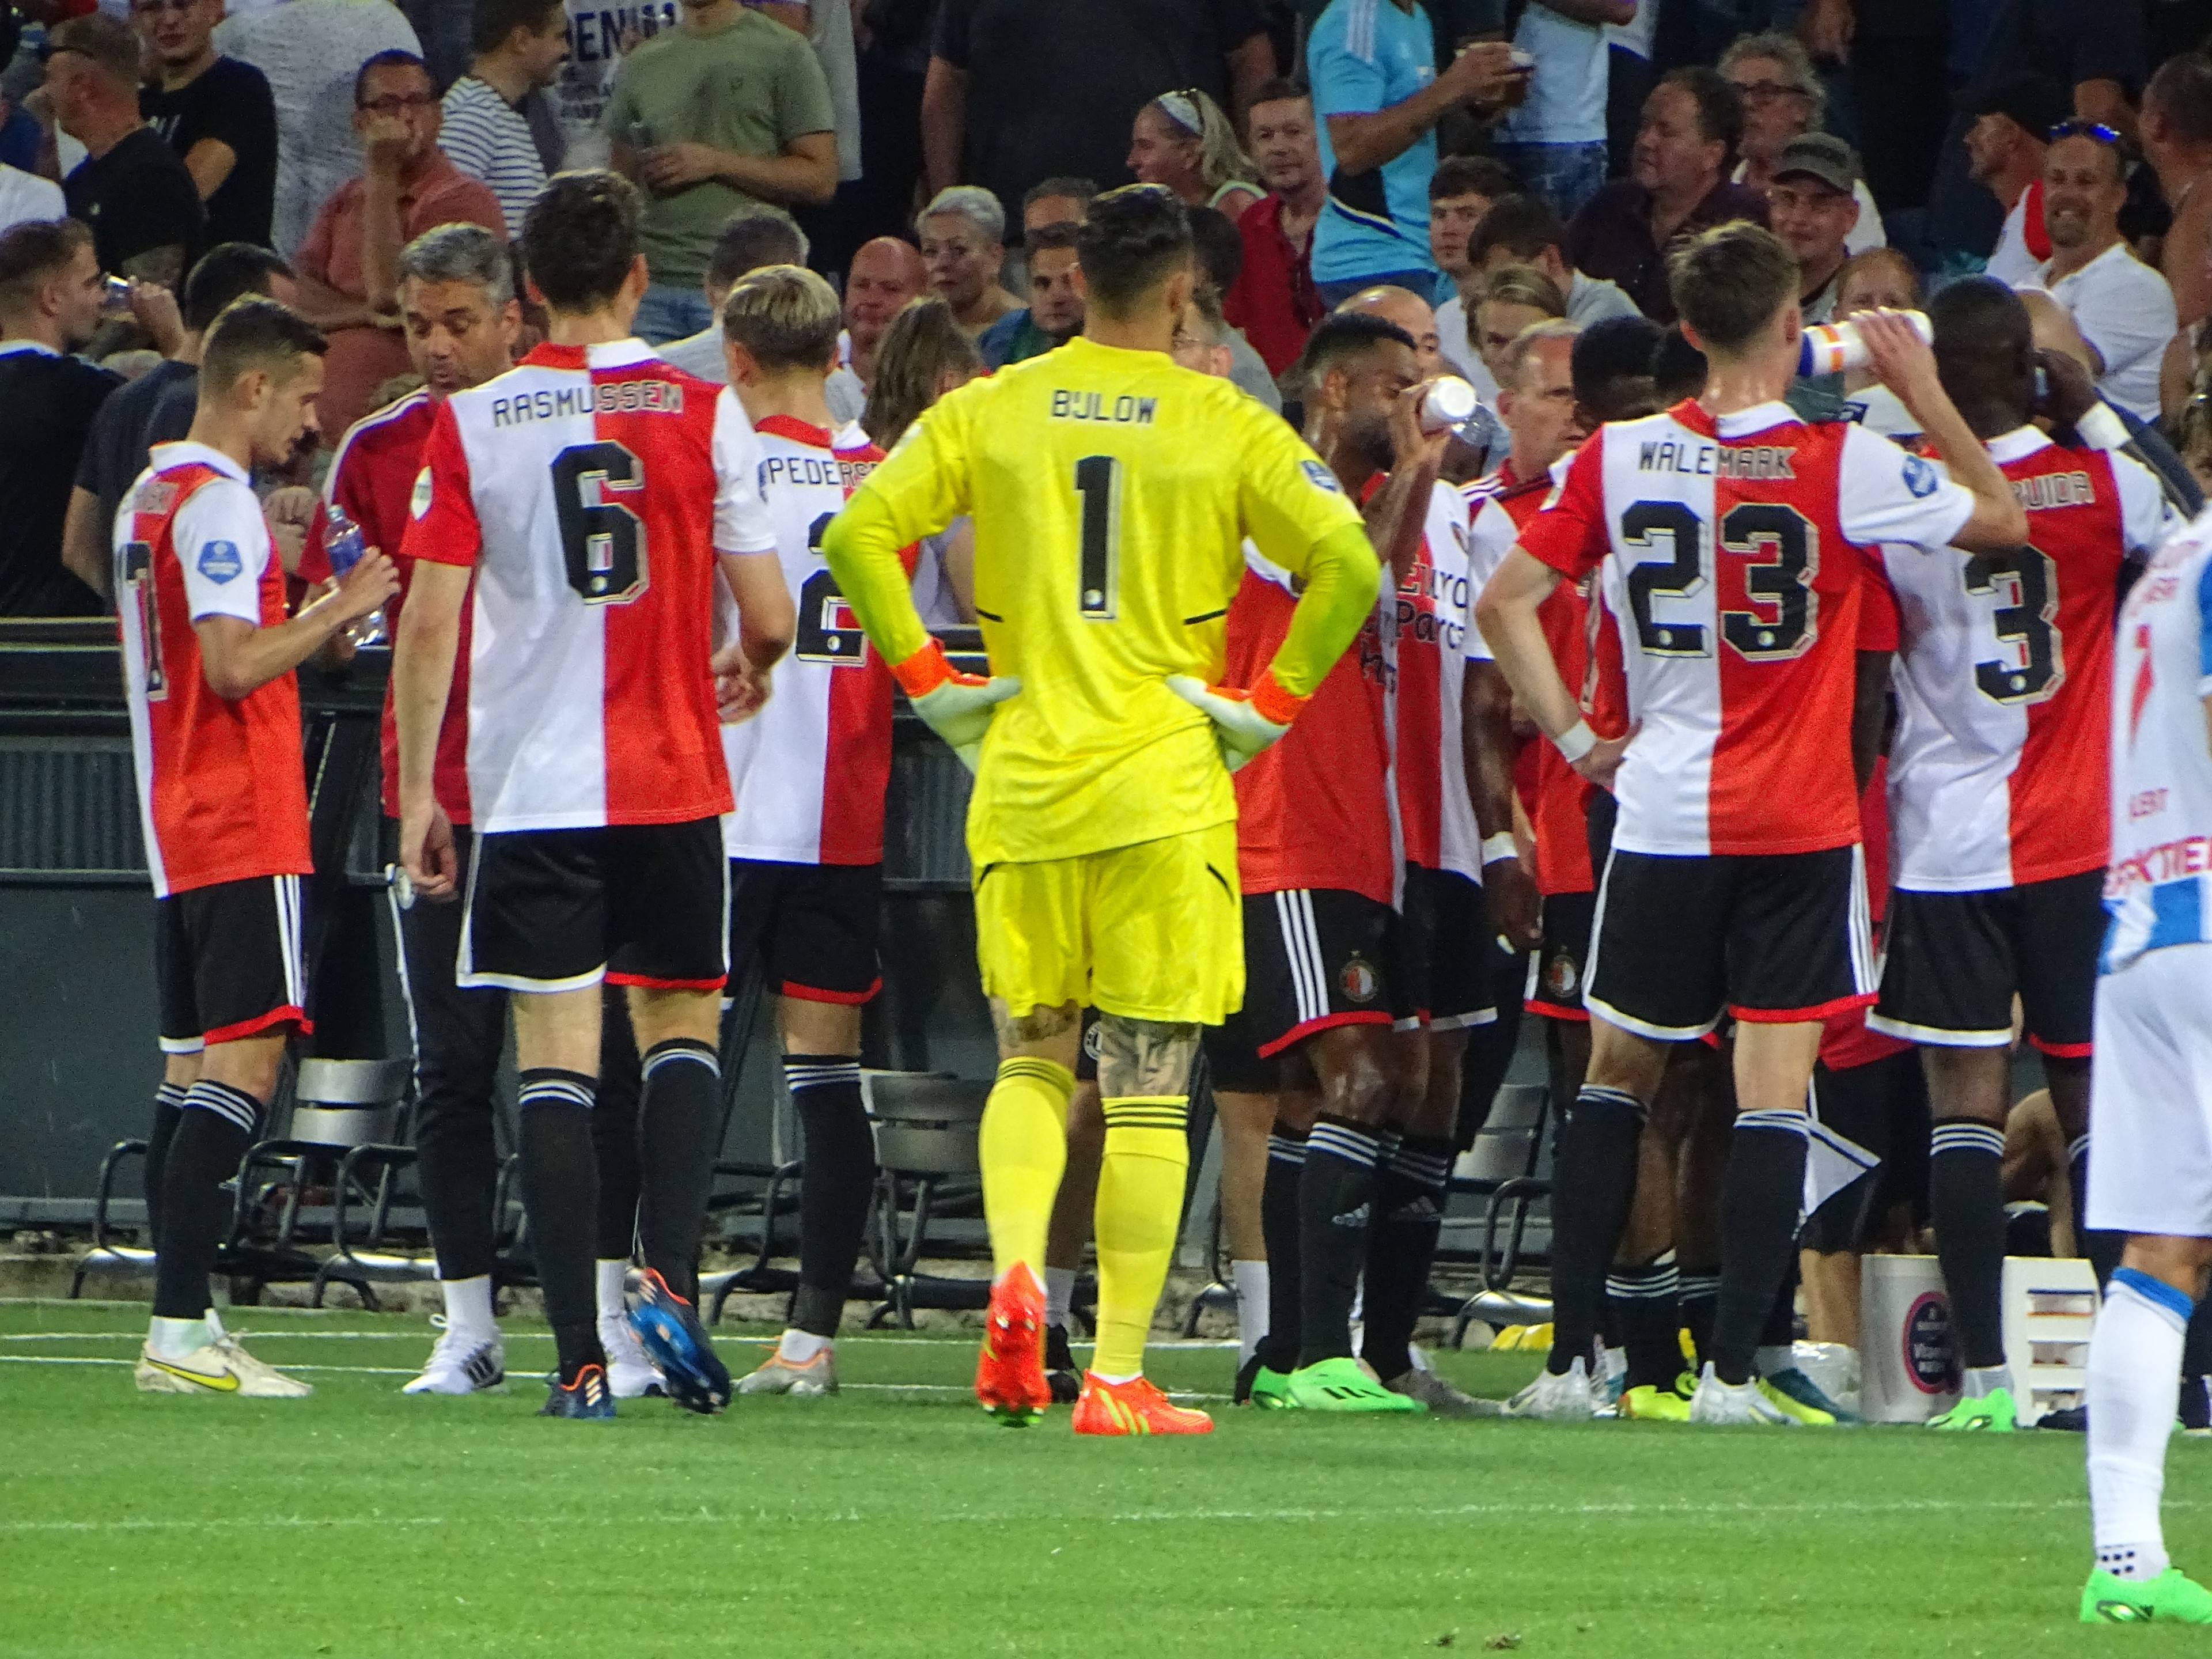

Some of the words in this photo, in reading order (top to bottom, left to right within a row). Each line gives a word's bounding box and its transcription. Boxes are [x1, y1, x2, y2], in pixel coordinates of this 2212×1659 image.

[493, 380, 683, 427] RASMUSSEN
[767, 457, 880, 486] PEDERS
[550, 440, 649, 606] 6
[1074, 454, 1121, 619] 1
[1621, 499, 1819, 661] 23
[1964, 544, 2065, 704] 3
